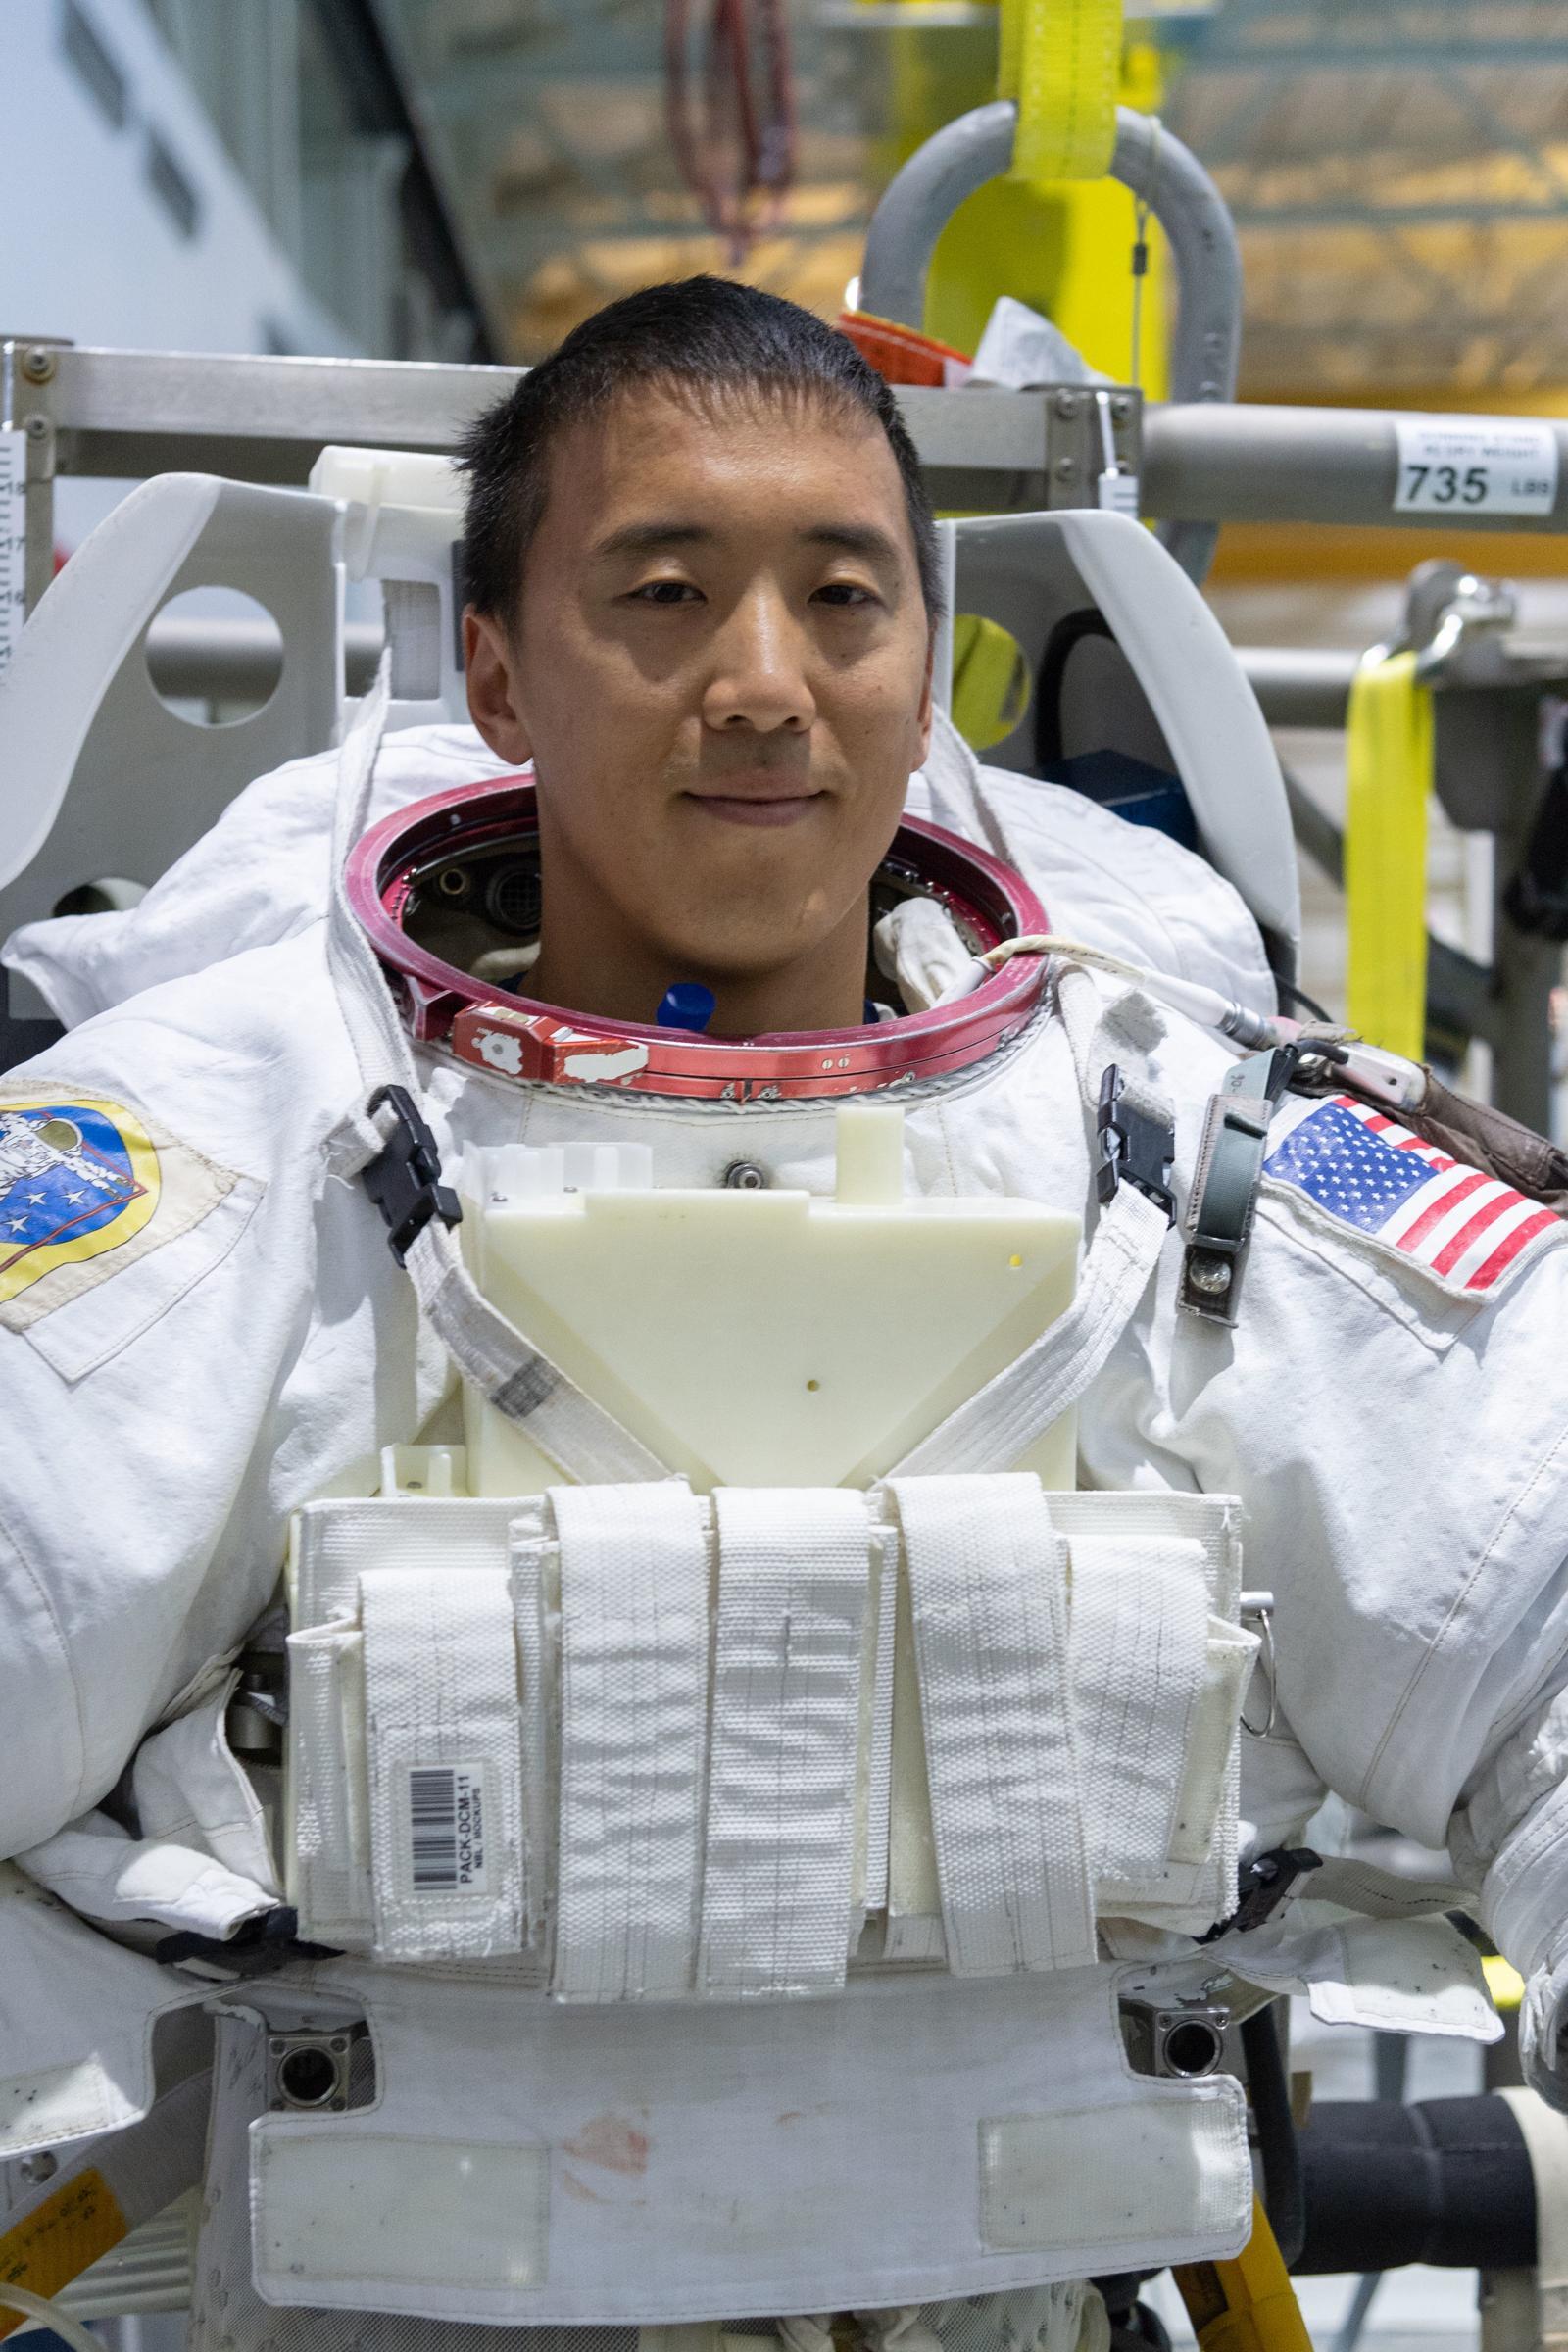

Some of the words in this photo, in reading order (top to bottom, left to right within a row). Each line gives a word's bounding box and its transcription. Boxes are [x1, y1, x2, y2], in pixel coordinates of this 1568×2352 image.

[1406, 464, 1489, 504] 735
[457, 1775, 473, 1884] PACK-DCM-11
[472, 1788, 483, 1839] MOCKUPS
